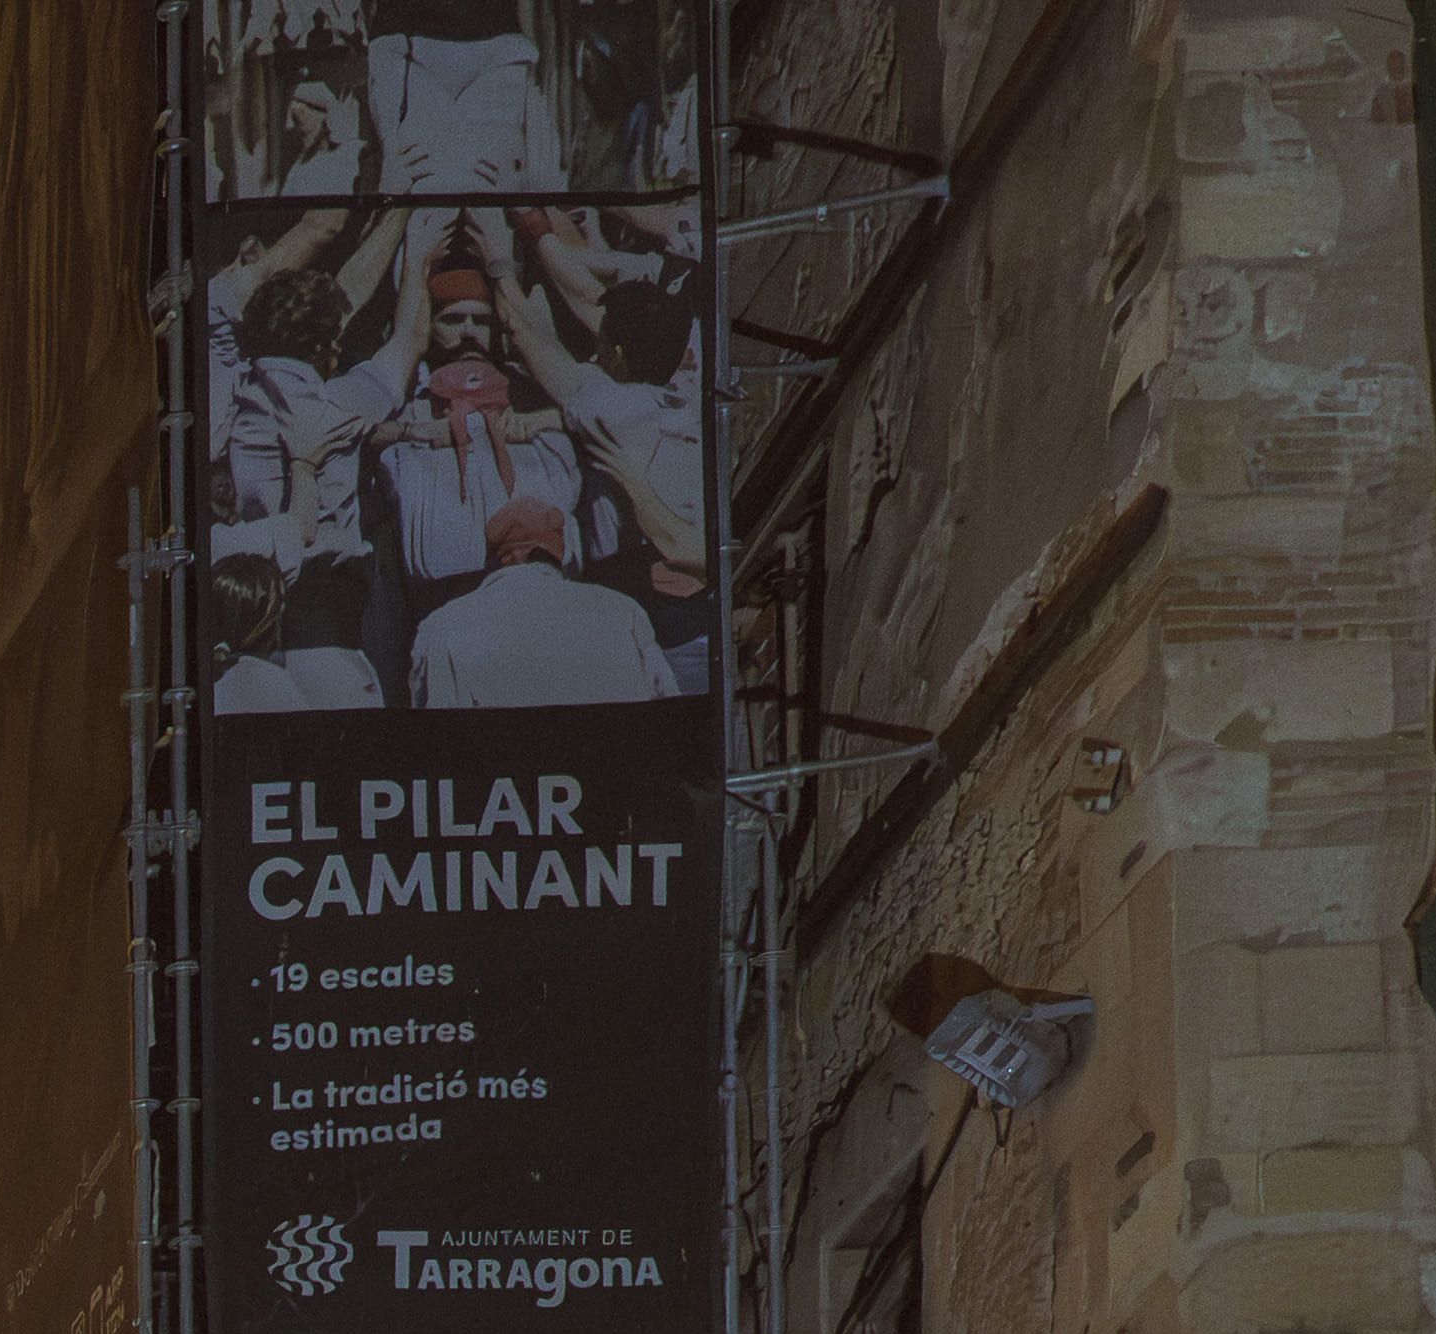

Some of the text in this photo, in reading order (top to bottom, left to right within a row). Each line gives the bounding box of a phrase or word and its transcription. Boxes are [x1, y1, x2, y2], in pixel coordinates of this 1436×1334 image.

[251, 775, 584, 843] EL PILAR
[248, 842, 683, 921] CAMINANT
[270, 954, 455, 993] 19 escales
[271, 1018, 476, 1052] 500 metres
[272, 1068, 548, 1111] La tradició més
[270, 1113, 442, 1151] estimada
[441, 1228, 633, 1248] AJUNTAMENT DE
